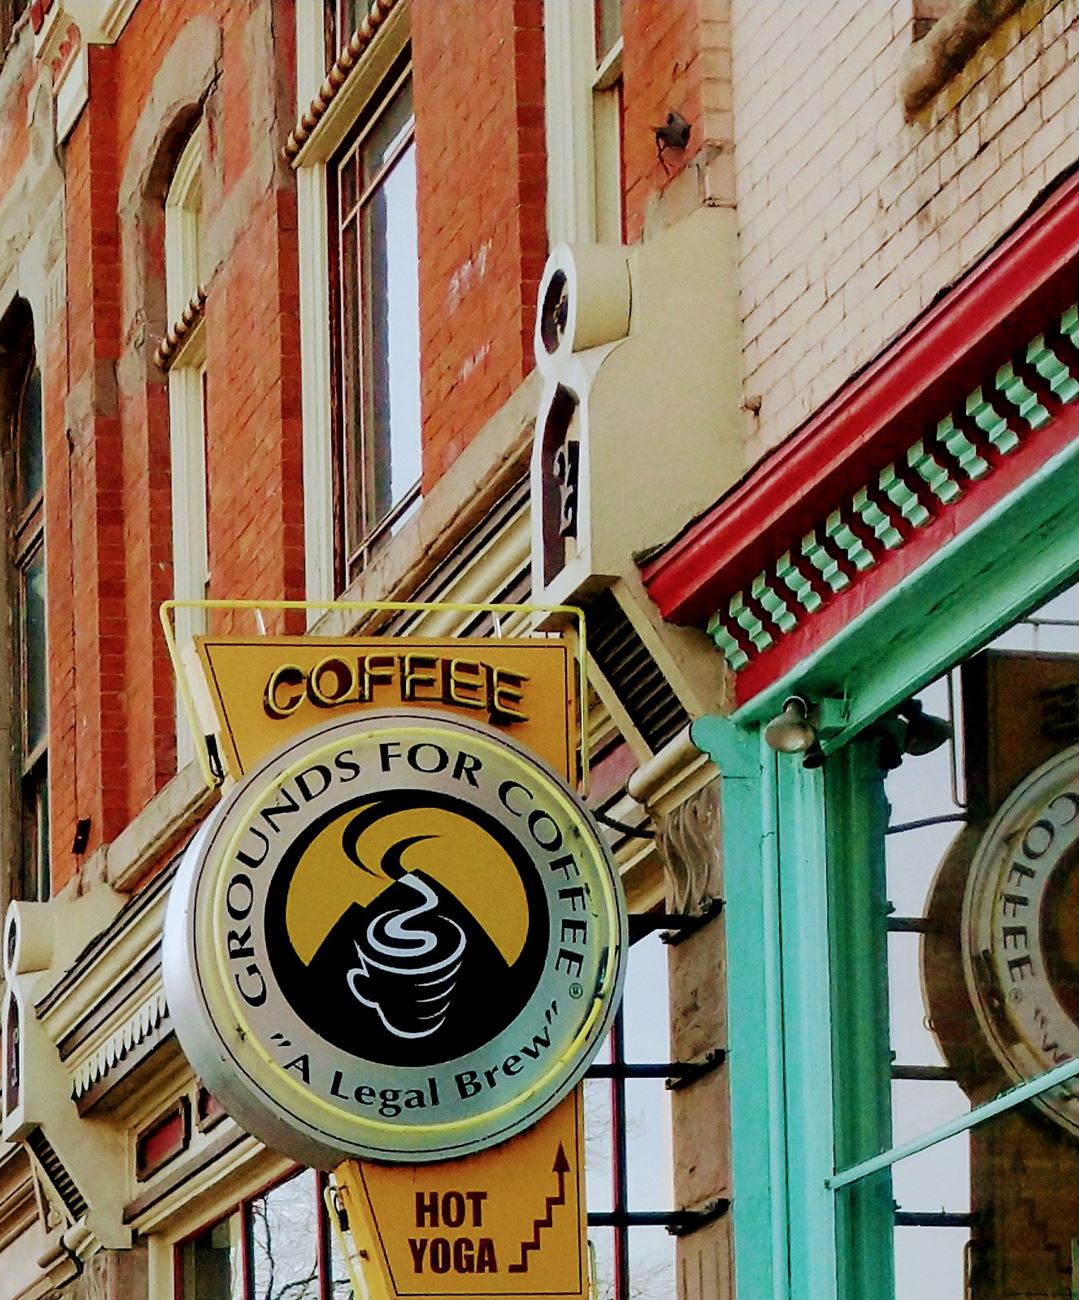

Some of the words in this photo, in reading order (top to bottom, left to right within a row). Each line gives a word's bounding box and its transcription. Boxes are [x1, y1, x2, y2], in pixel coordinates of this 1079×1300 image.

[263, 653, 532, 724] COFFEE
[224, 742, 362, 1008] GROUNDS
[379, 741, 484, 790] FOR
[498, 777, 589, 981] COFFEE
[329, 1071, 440, 1118] Legal
[414, 1191, 488, 1229] HOT
[408, 1236, 499, 1275] YOGA
